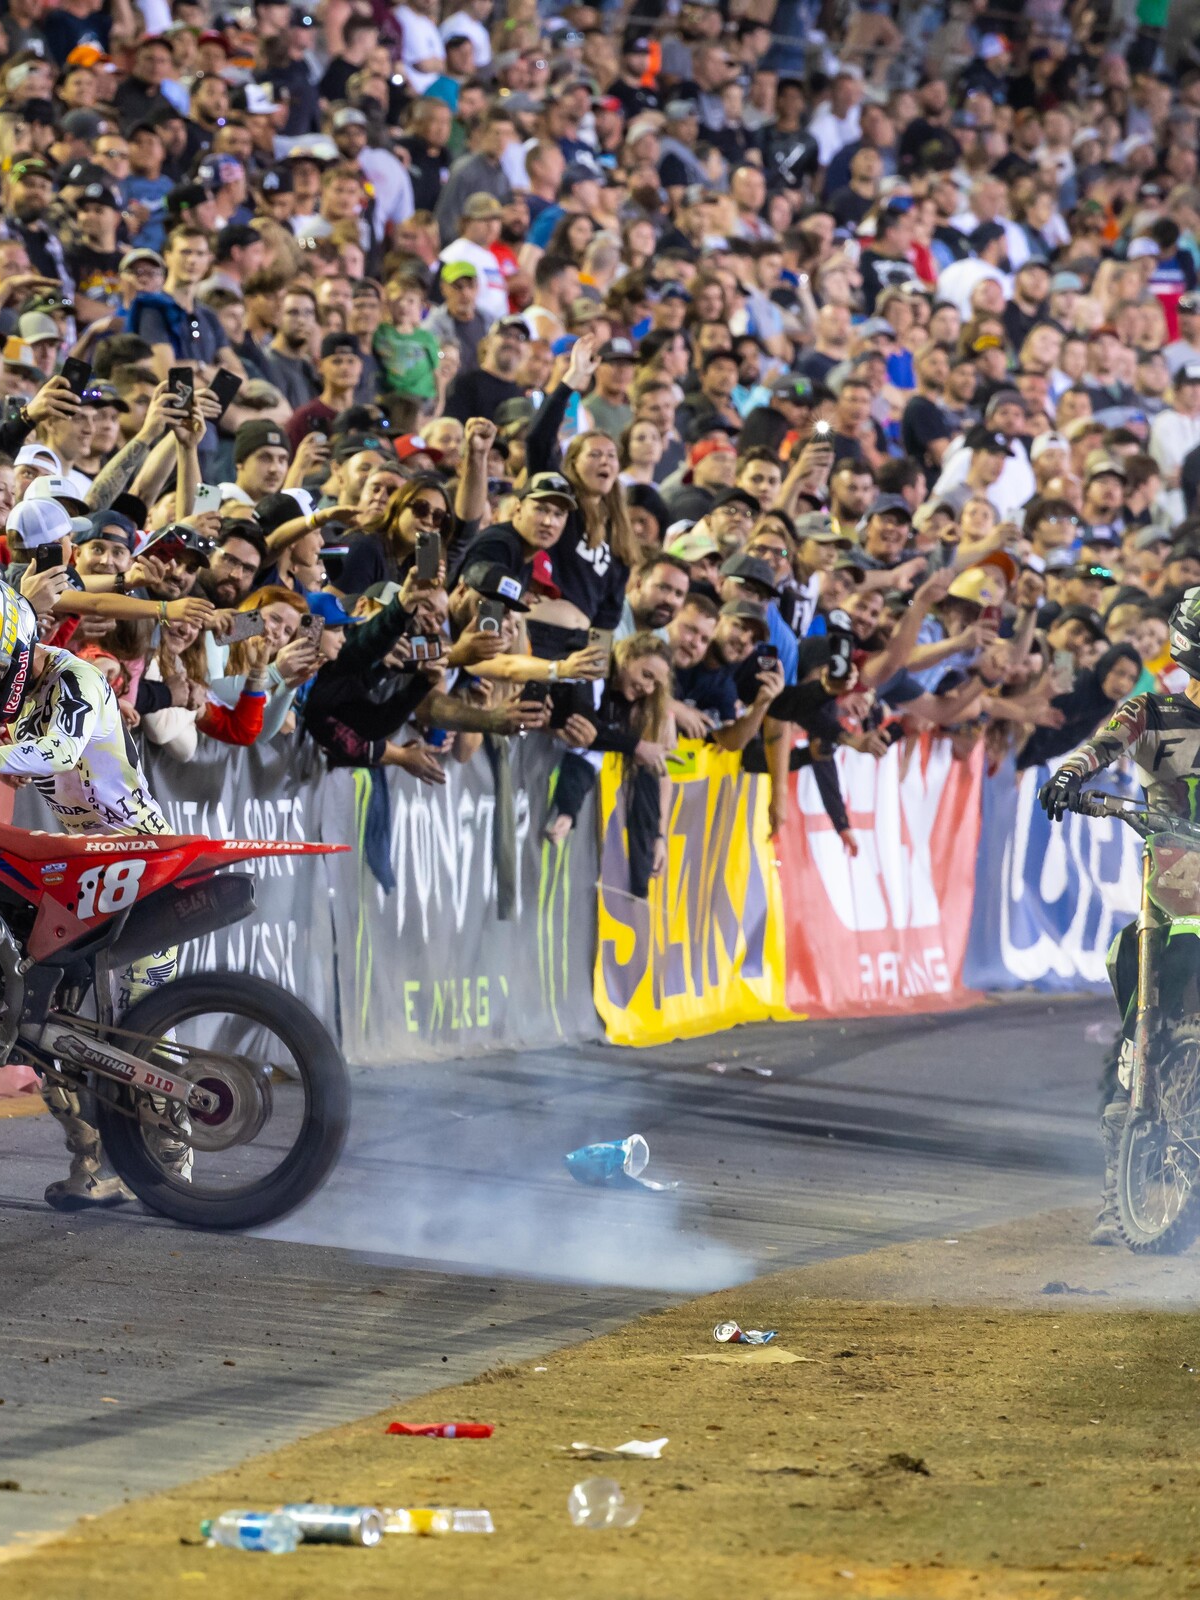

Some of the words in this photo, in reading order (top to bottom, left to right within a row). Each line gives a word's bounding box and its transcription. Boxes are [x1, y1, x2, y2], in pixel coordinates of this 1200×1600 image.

[1054, 770, 1074, 789] FOX
[84, 840, 160, 852] HONDA
[221, 840, 305, 850] DUNLOP
[377, 768, 531, 944] MONSTR
[76, 858, 147, 920] 18
[858, 944, 952, 1000] RAING
